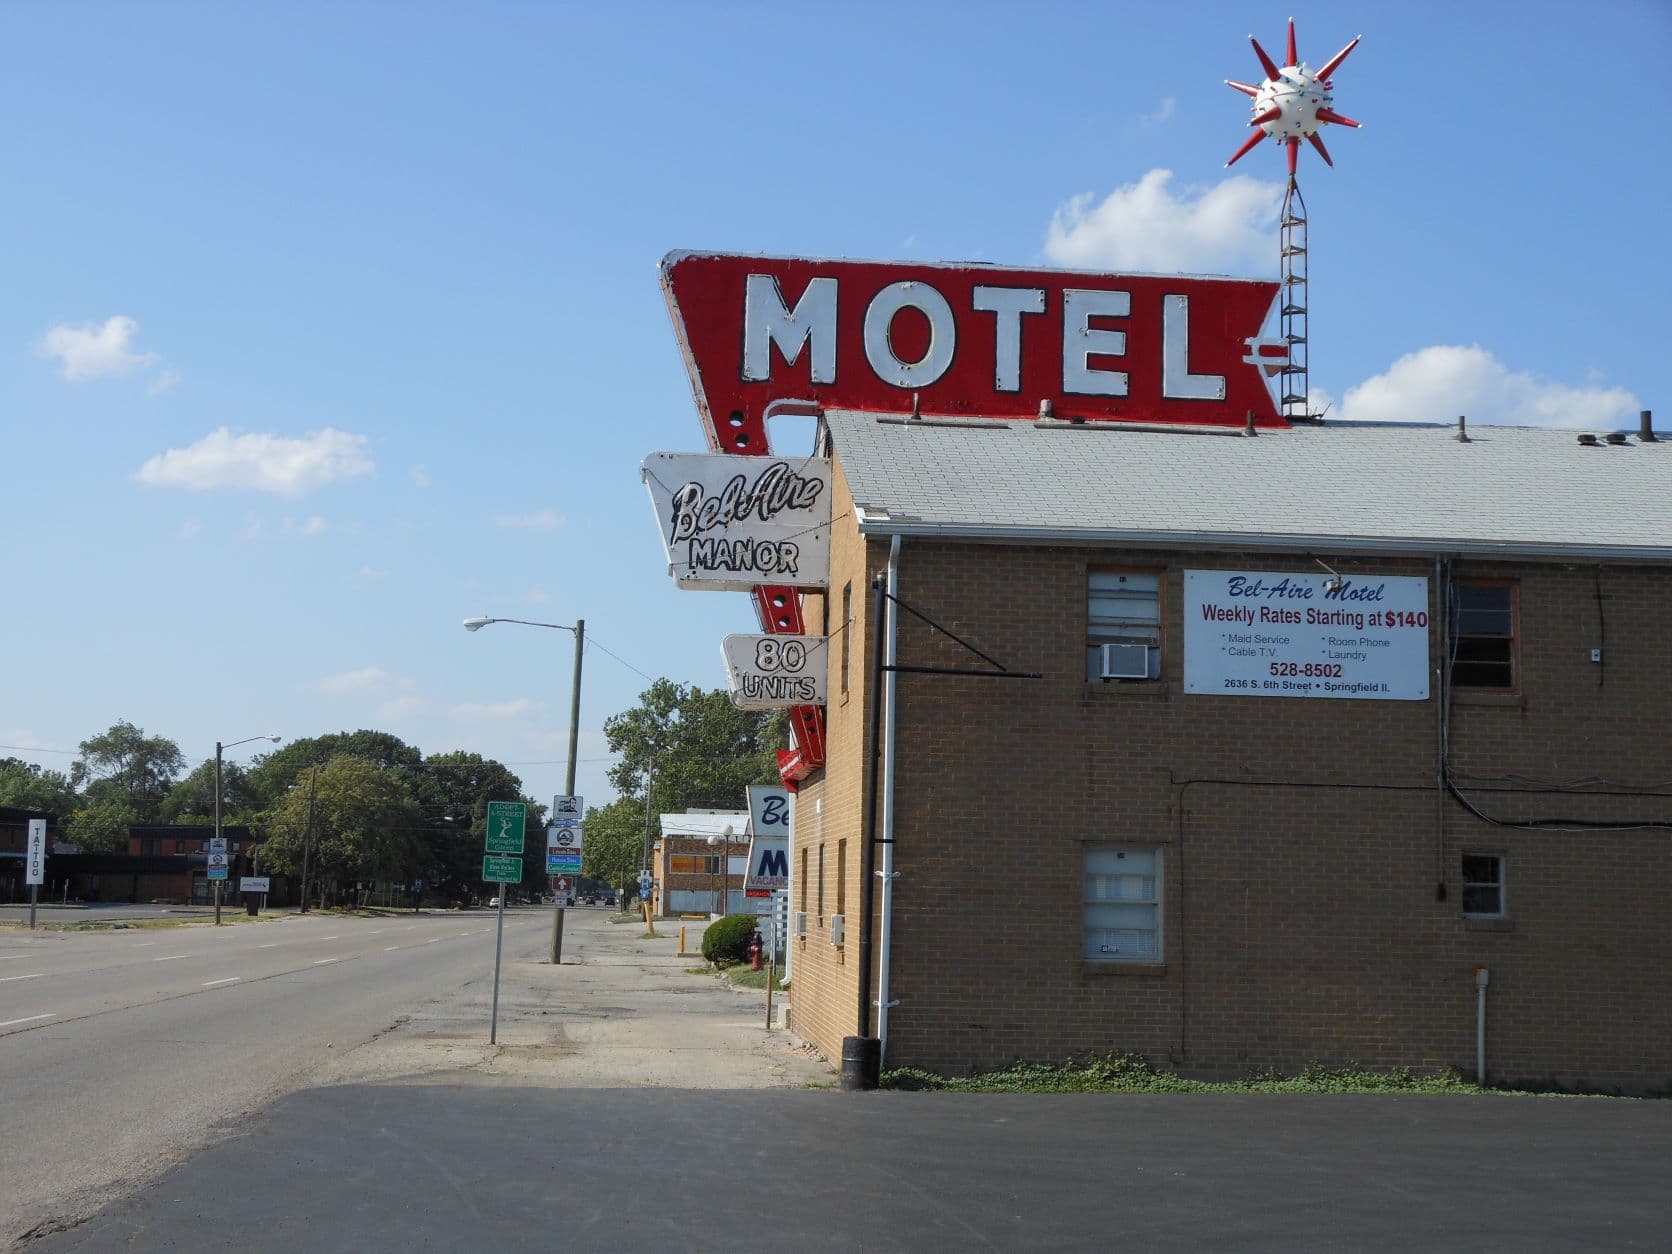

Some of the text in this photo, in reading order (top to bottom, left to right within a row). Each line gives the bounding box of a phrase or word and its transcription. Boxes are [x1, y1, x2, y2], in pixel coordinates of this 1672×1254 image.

[741, 273, 1227, 401] MOTEL
[689, 537, 799, 573] MANOR
[1228, 576, 1384, 601] Bel-Aire Motel
[1202, 604, 1428, 630] Weekly Rates Starting at $140
[1228, 634, 1290, 644] Maid Service
[1228, 647, 1256, 656] Cable
[1328, 637, 1391, 647] Room Phone
[755, 638, 806, 673] 80
[1328, 650, 1367, 661] Laundry
[1270, 663, 1342, 677] 528-8502
[743, 675, 816, 700] UNITS
[1224, 679, 1248, 688] 2636
[1250, 680, 1260, 688] S.
[1263, 680, 1279, 689] 6th
[1282, 681, 1312, 690] Street
[1324, 682, 1379, 693] Springfield
[32, 828, 40, 876] TATTOO
